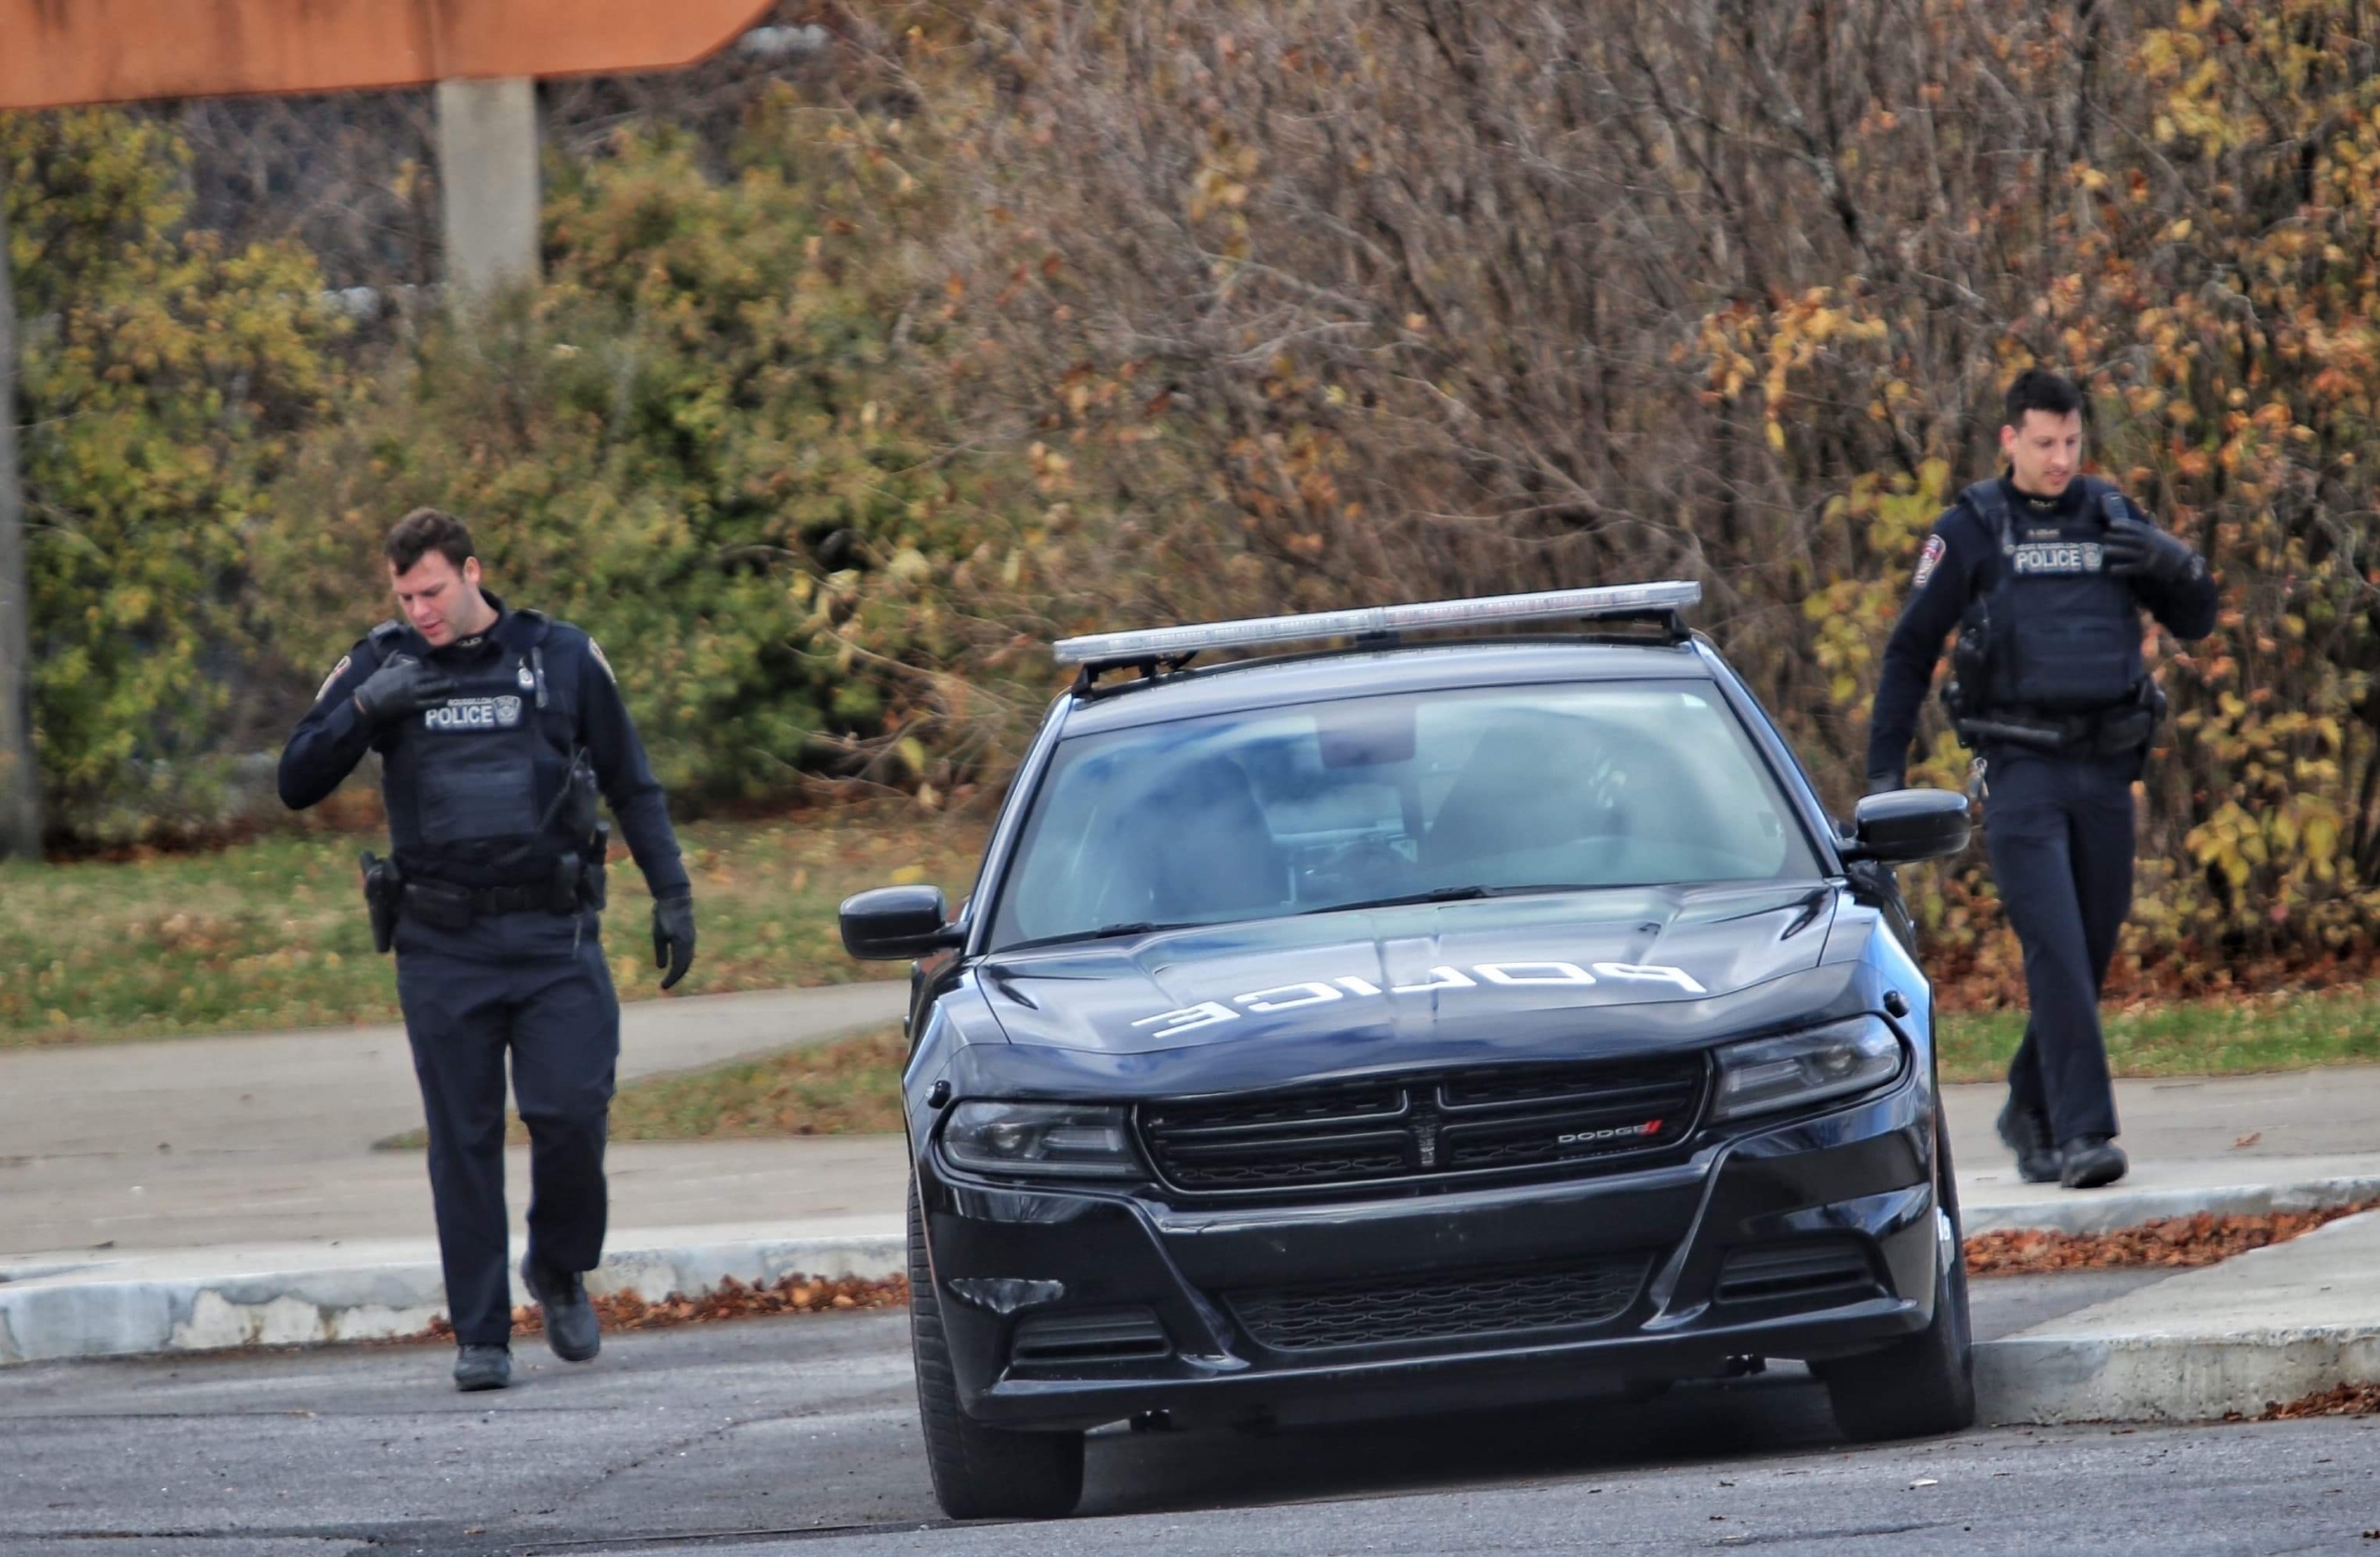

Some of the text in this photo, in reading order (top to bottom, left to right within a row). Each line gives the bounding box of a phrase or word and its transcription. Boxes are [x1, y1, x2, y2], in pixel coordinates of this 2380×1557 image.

[2015, 549, 2082, 572] POLICE
[425, 706, 495, 728] POLICE
[1558, 1124, 1648, 1143] DODGE
